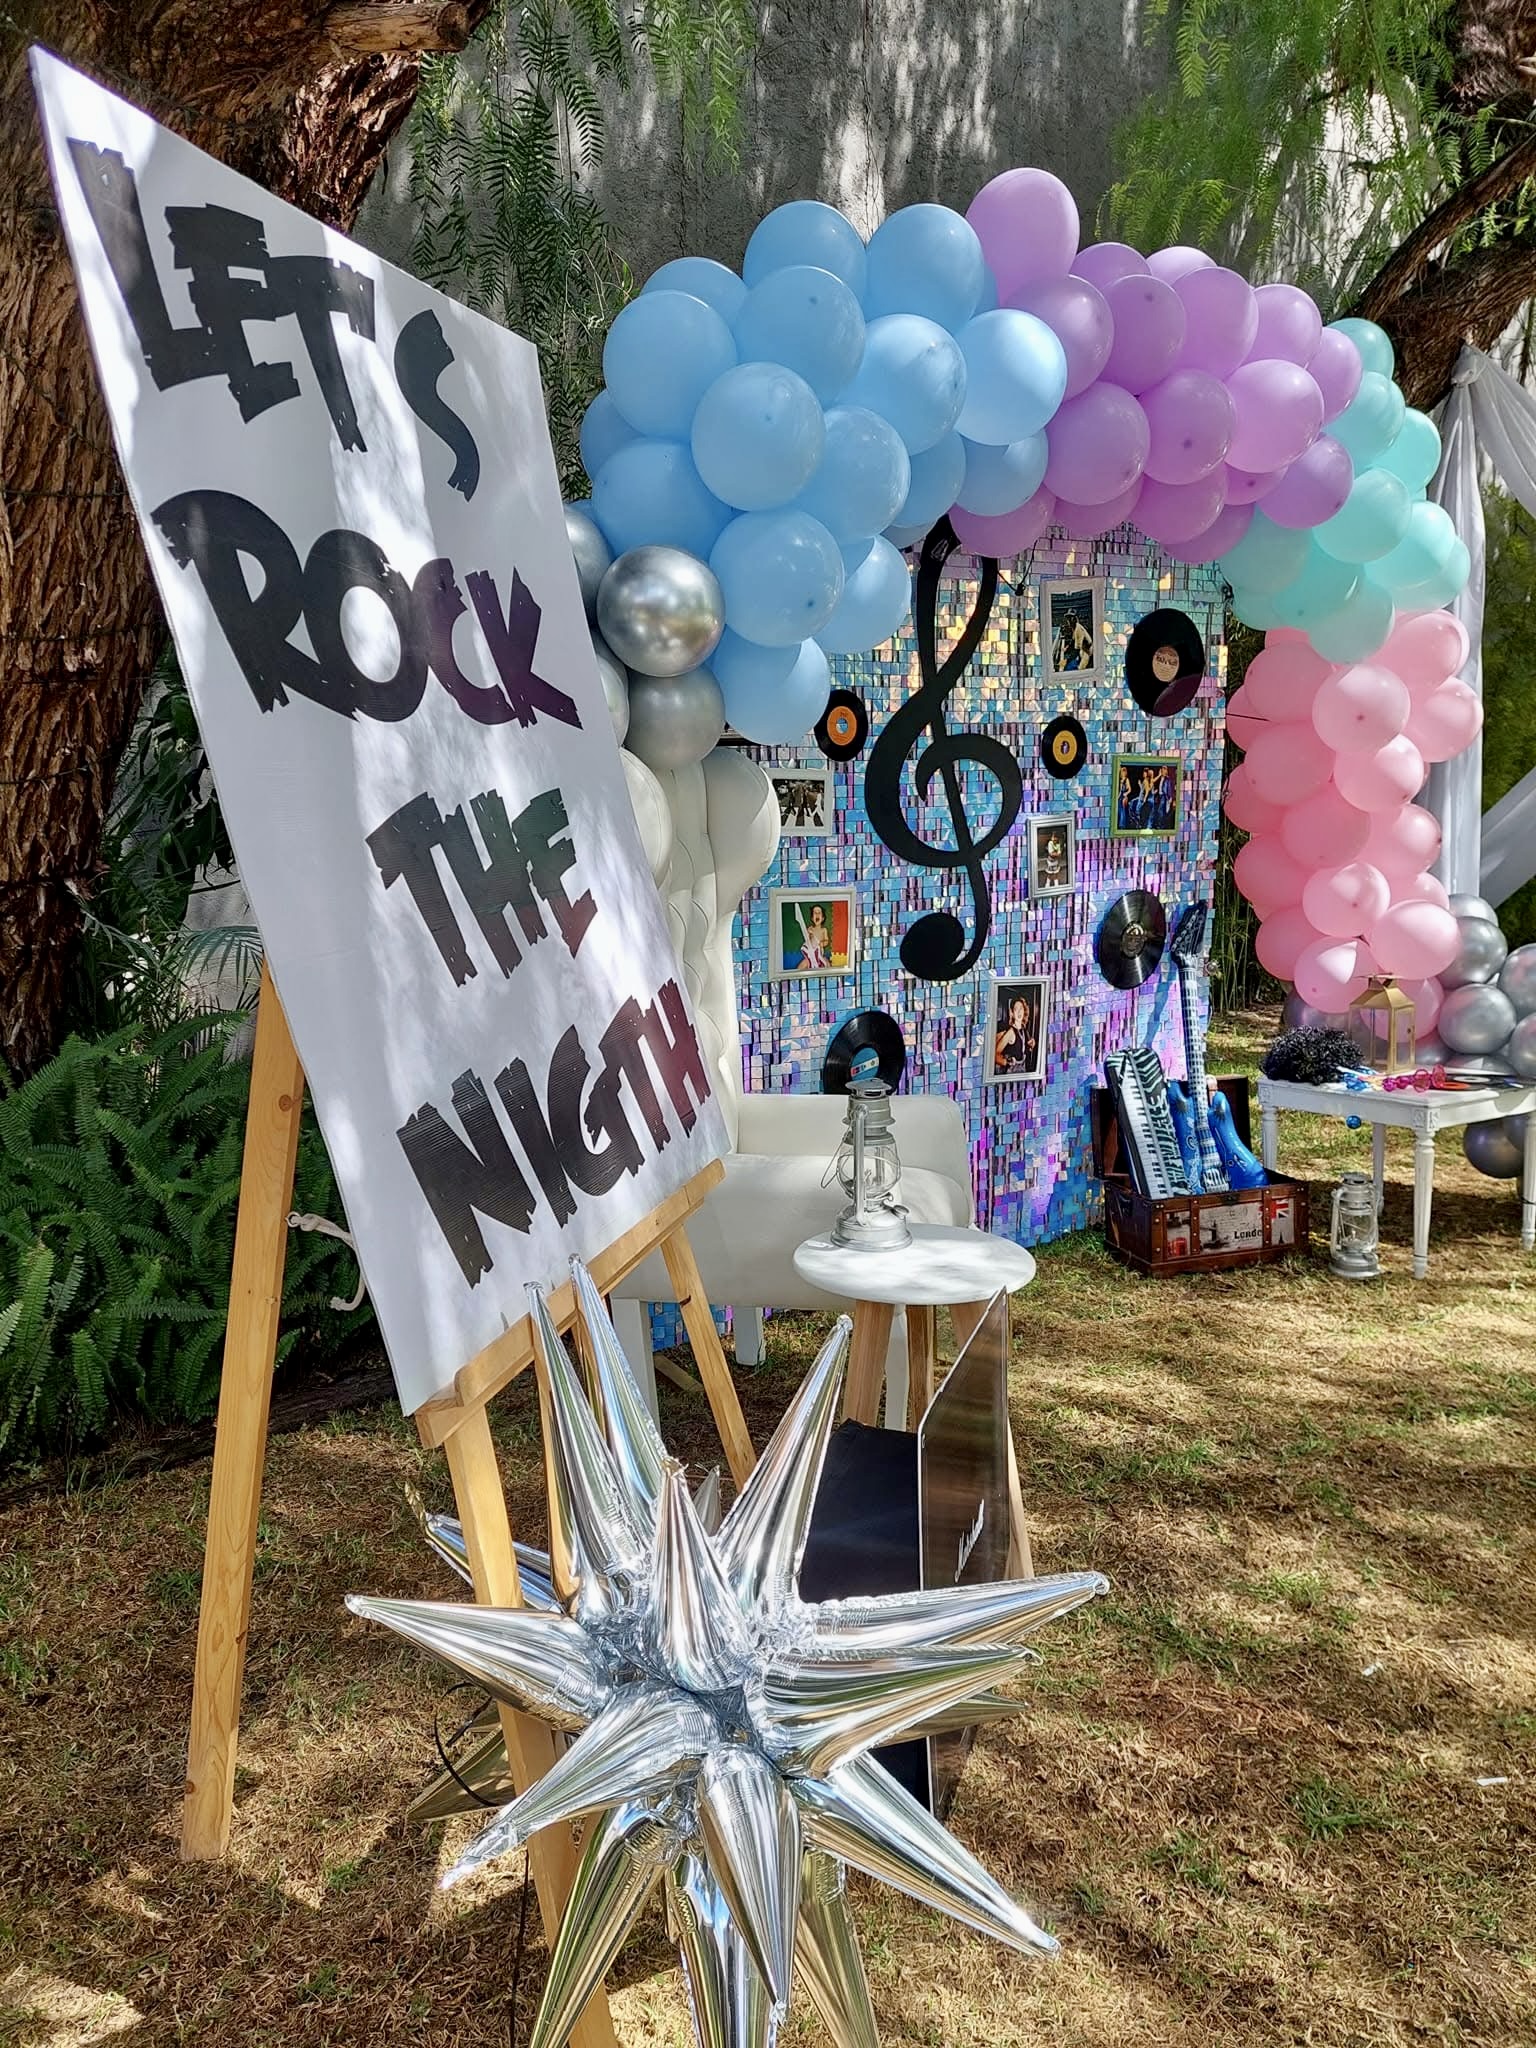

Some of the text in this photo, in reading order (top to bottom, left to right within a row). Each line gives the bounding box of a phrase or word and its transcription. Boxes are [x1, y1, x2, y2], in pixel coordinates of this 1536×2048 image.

[150, 489, 583, 730] ROCK
[365, 788, 597, 987] THE
[396, 978, 711, 1289] NIGTH
[1234, 1229, 1262, 1239] Londo
